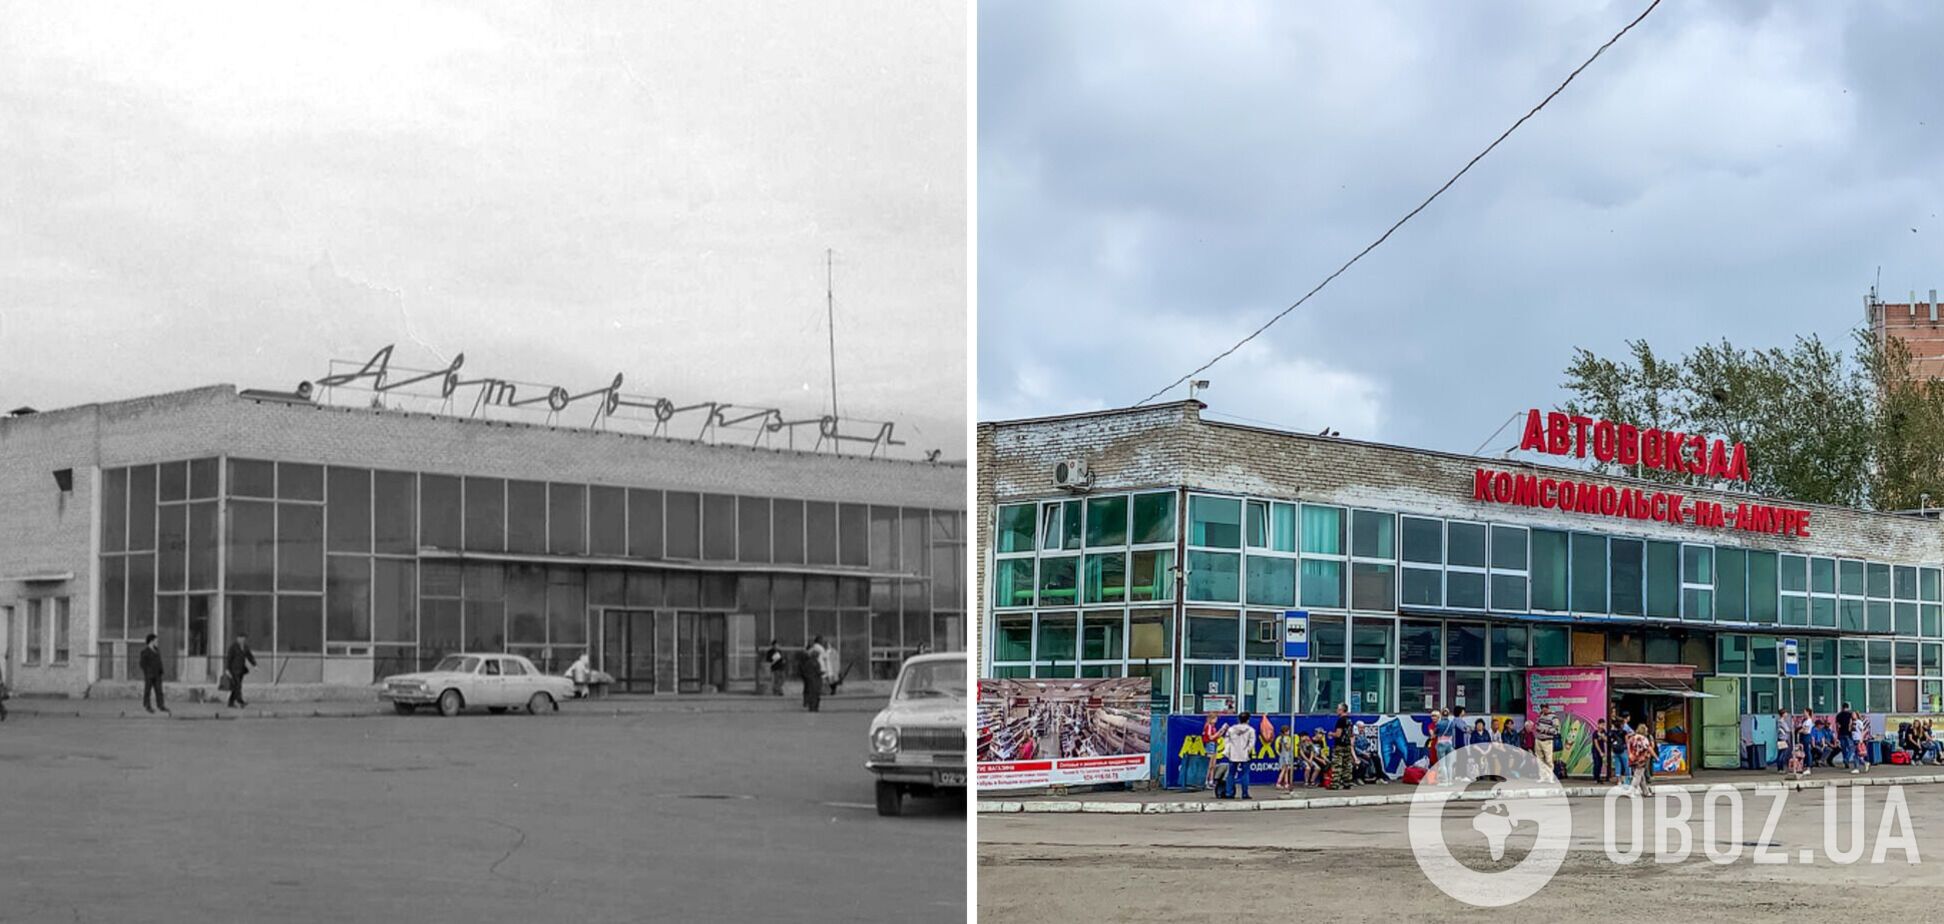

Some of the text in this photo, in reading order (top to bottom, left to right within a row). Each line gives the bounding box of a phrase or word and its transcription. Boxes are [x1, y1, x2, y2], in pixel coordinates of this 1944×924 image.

[1520, 408, 1751, 482] АВТОВОКЗАЛ
[1473, 468, 1812, 538] КОМСОМОЛЬСК-НА-АМУРЕ
[1249, 761, 1287, 773] ОДЕЖД
